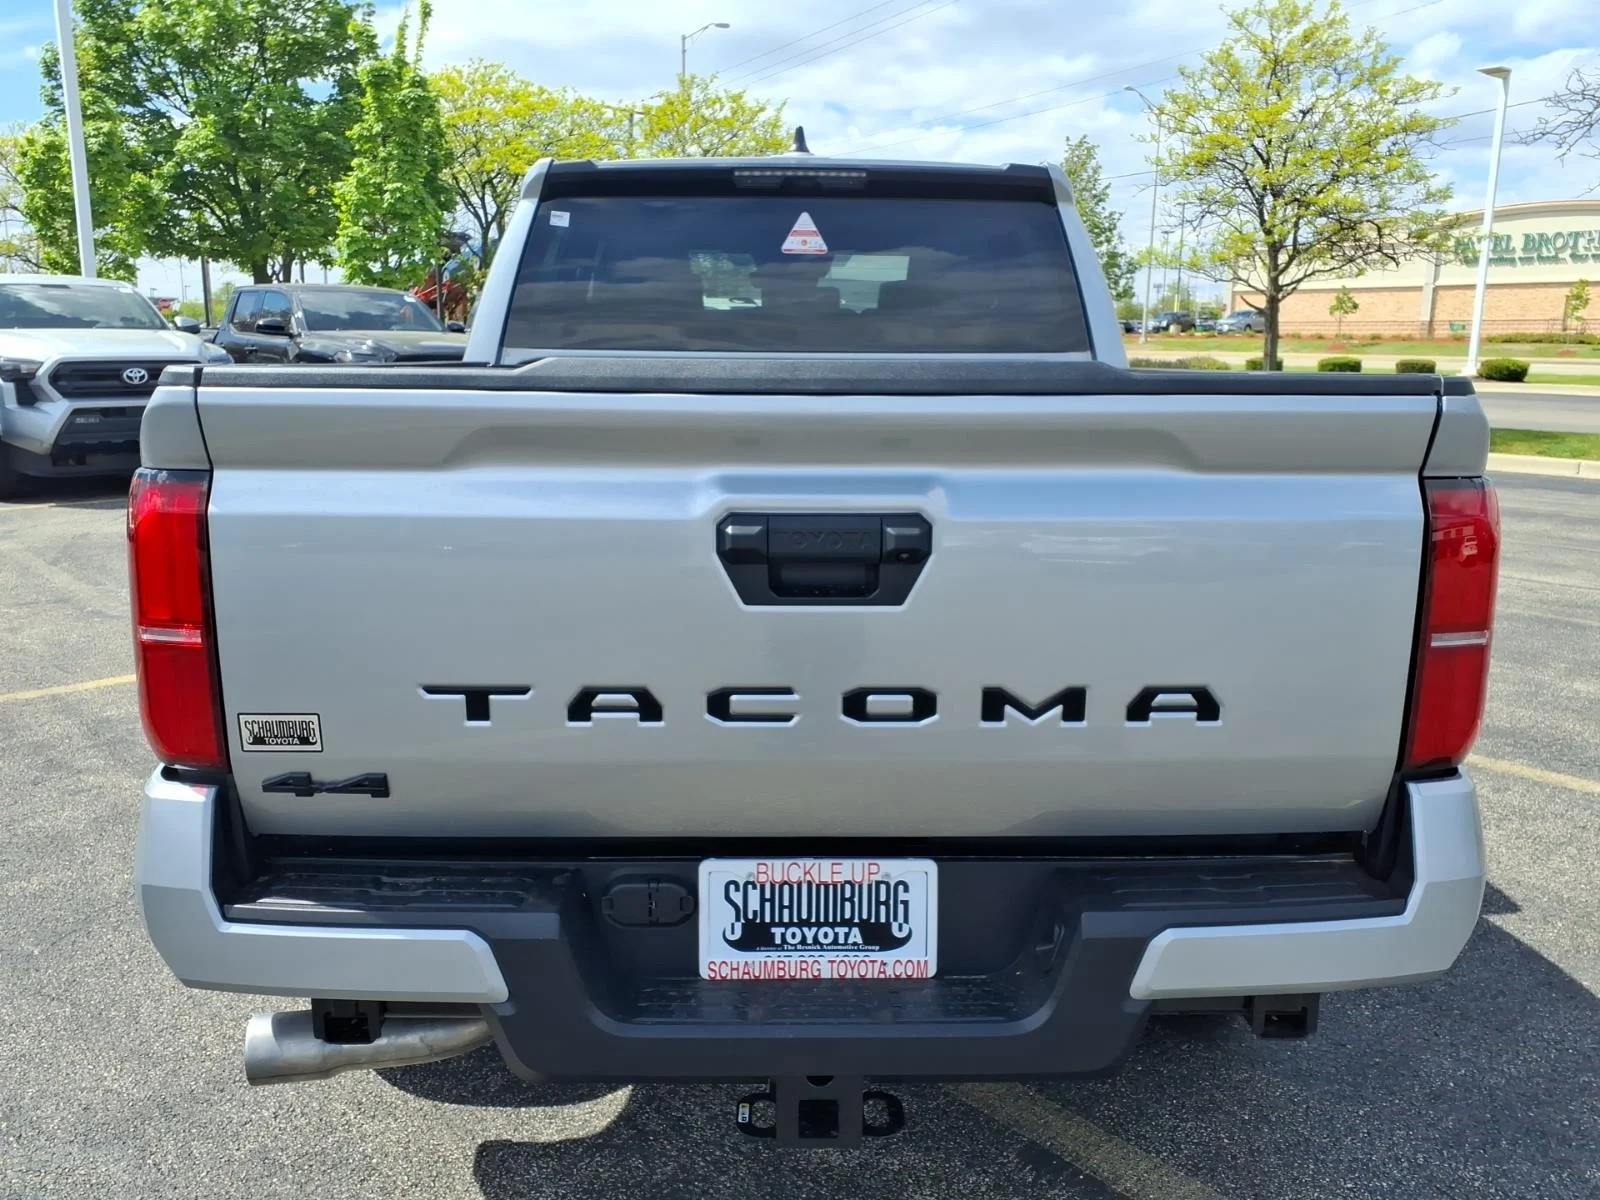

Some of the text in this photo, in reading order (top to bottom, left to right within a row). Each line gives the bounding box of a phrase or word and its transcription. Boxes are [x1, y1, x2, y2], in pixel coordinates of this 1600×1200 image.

[776, 531, 873, 549] TOYOTA
[418, 686, 1223, 728] TACOMA
[244, 719, 316, 740] SCHAUMBURG
[264, 737, 300, 745] TOYOTA
[755, 862, 881, 884] BUCKLE UP
[724, 880, 910, 926] SCHAUMBURG
[771, 926, 863, 944] TOYOTA
[859, 944, 880, 952] Group
[708, 959, 929, 980] SCHAUMBURG TOYOTA.COM
